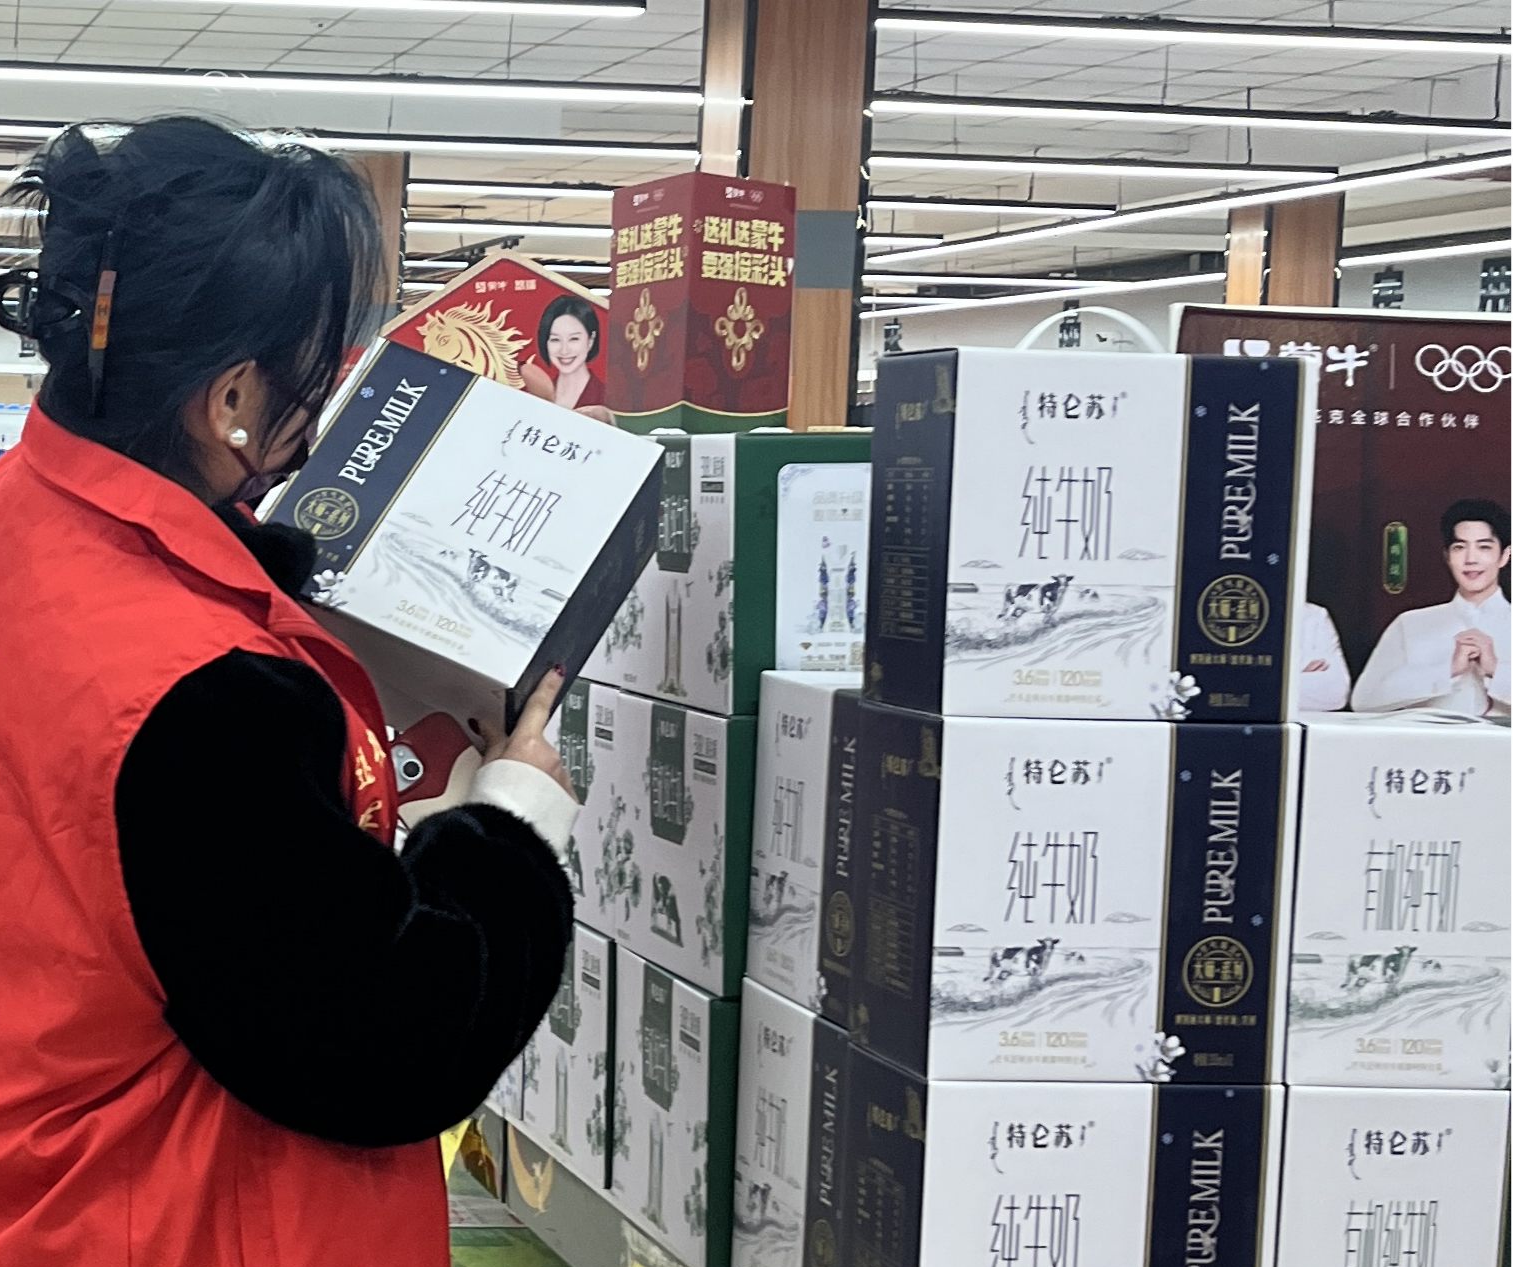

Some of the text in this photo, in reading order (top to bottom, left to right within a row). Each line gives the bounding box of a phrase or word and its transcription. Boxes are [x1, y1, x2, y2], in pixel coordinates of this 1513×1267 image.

[617, 213, 684, 255] 送礼送蒙牛
[703, 216, 785, 253] 送礼送蒙牛
[615, 247, 685, 288] 要强接彩头
[701, 250, 788, 288] 要强接彩头
[1038, 392, 1105, 419] 特仑苏
[521, 425, 583, 461] 特仑苏
[450, 470, 563, 557] 纯牛奶
[1019, 466, 1114, 561] 纯牛奶
[1024, 758, 1091, 785] 特仑苏
[1386, 769, 1452, 795] 特仑苏
[1004, 832, 1099, 924] 纯牛奶
[1006, 1123, 1074, 1149] 特仑苏
[1364, 1131, 1430, 1156] 特仑苏
